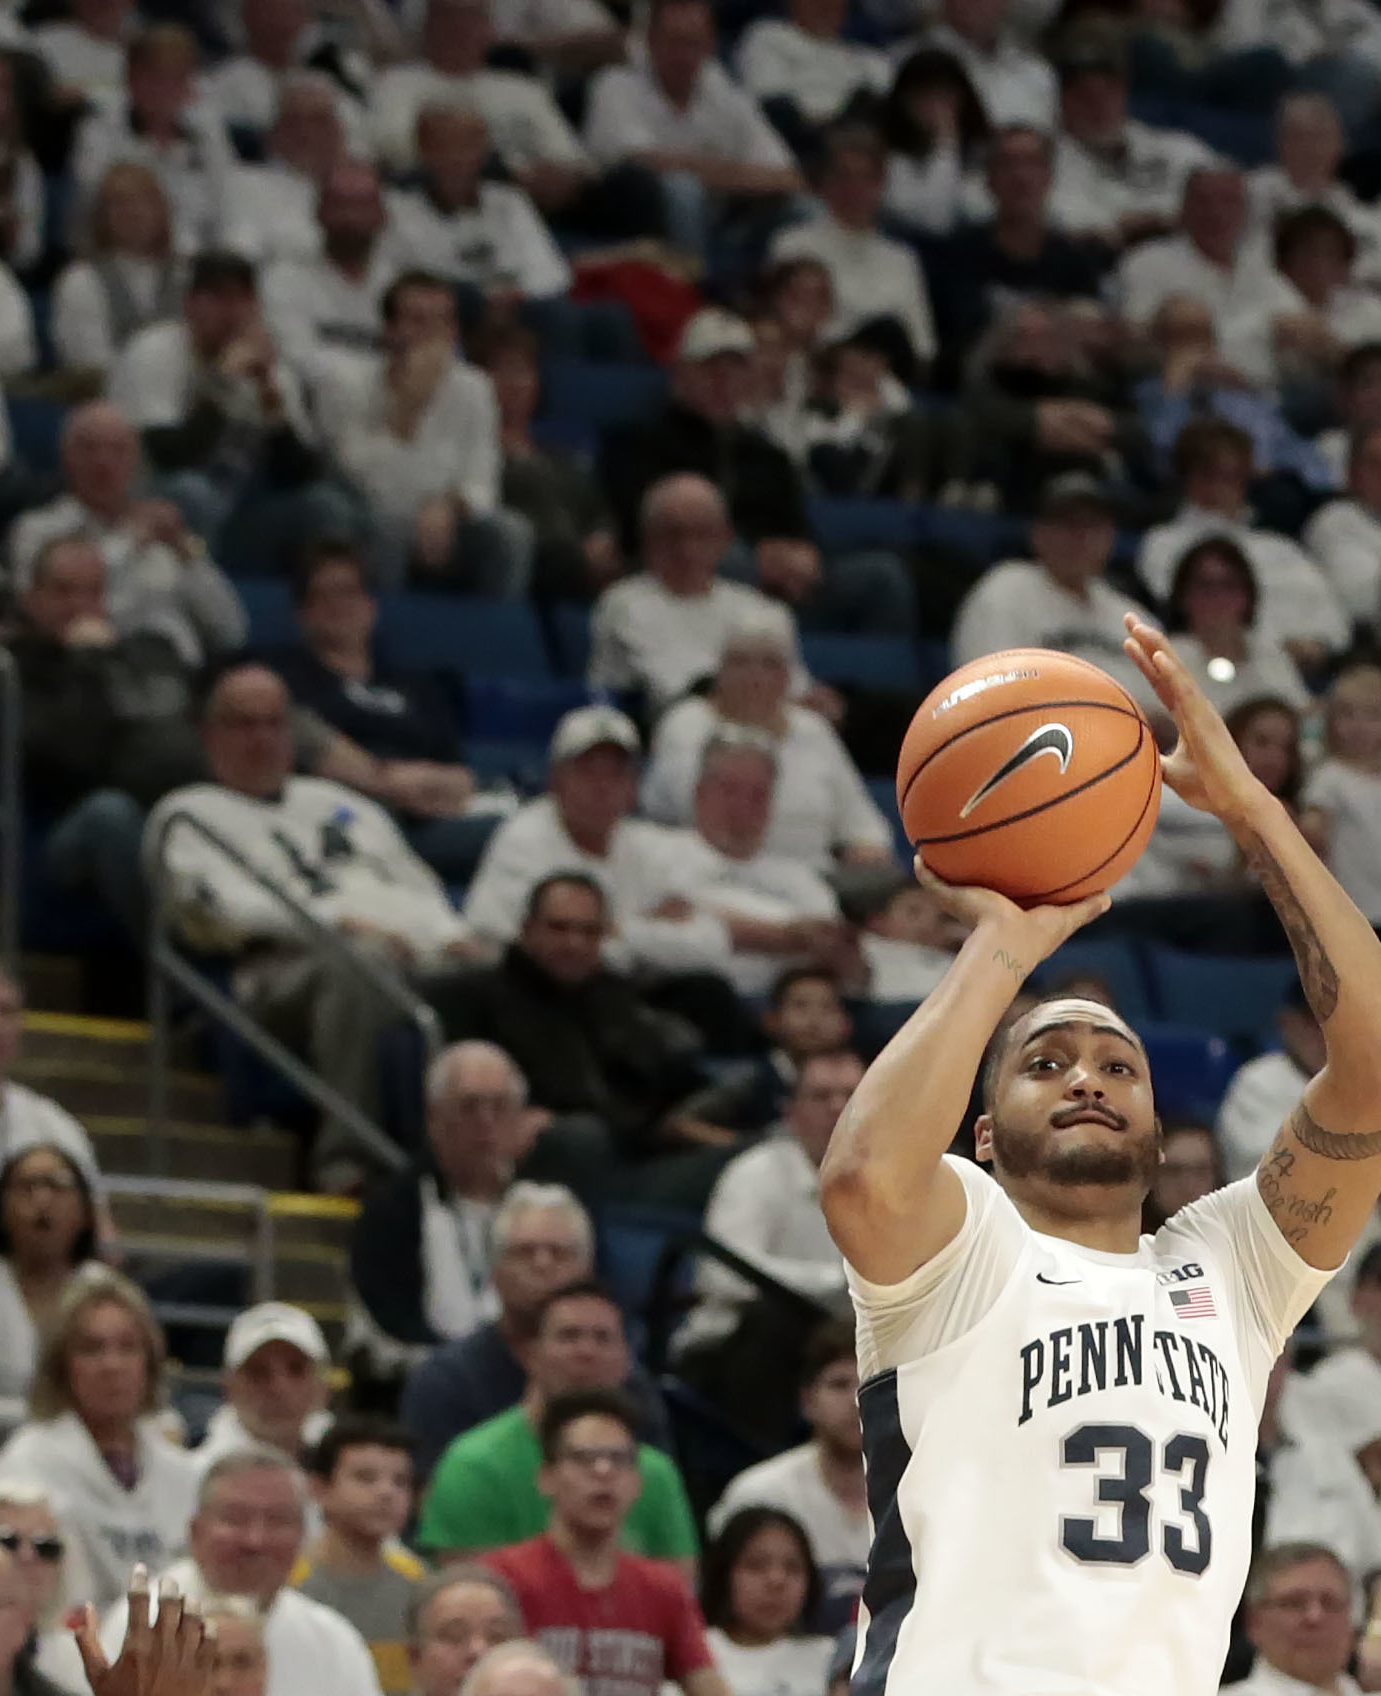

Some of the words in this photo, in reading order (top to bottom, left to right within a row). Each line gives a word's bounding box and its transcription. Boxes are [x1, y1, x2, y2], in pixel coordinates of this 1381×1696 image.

[1018, 1314, 1145, 1427] PENN
[1153, 1331, 1229, 1454] TATE
[1058, 1421, 1213, 1580] 33
